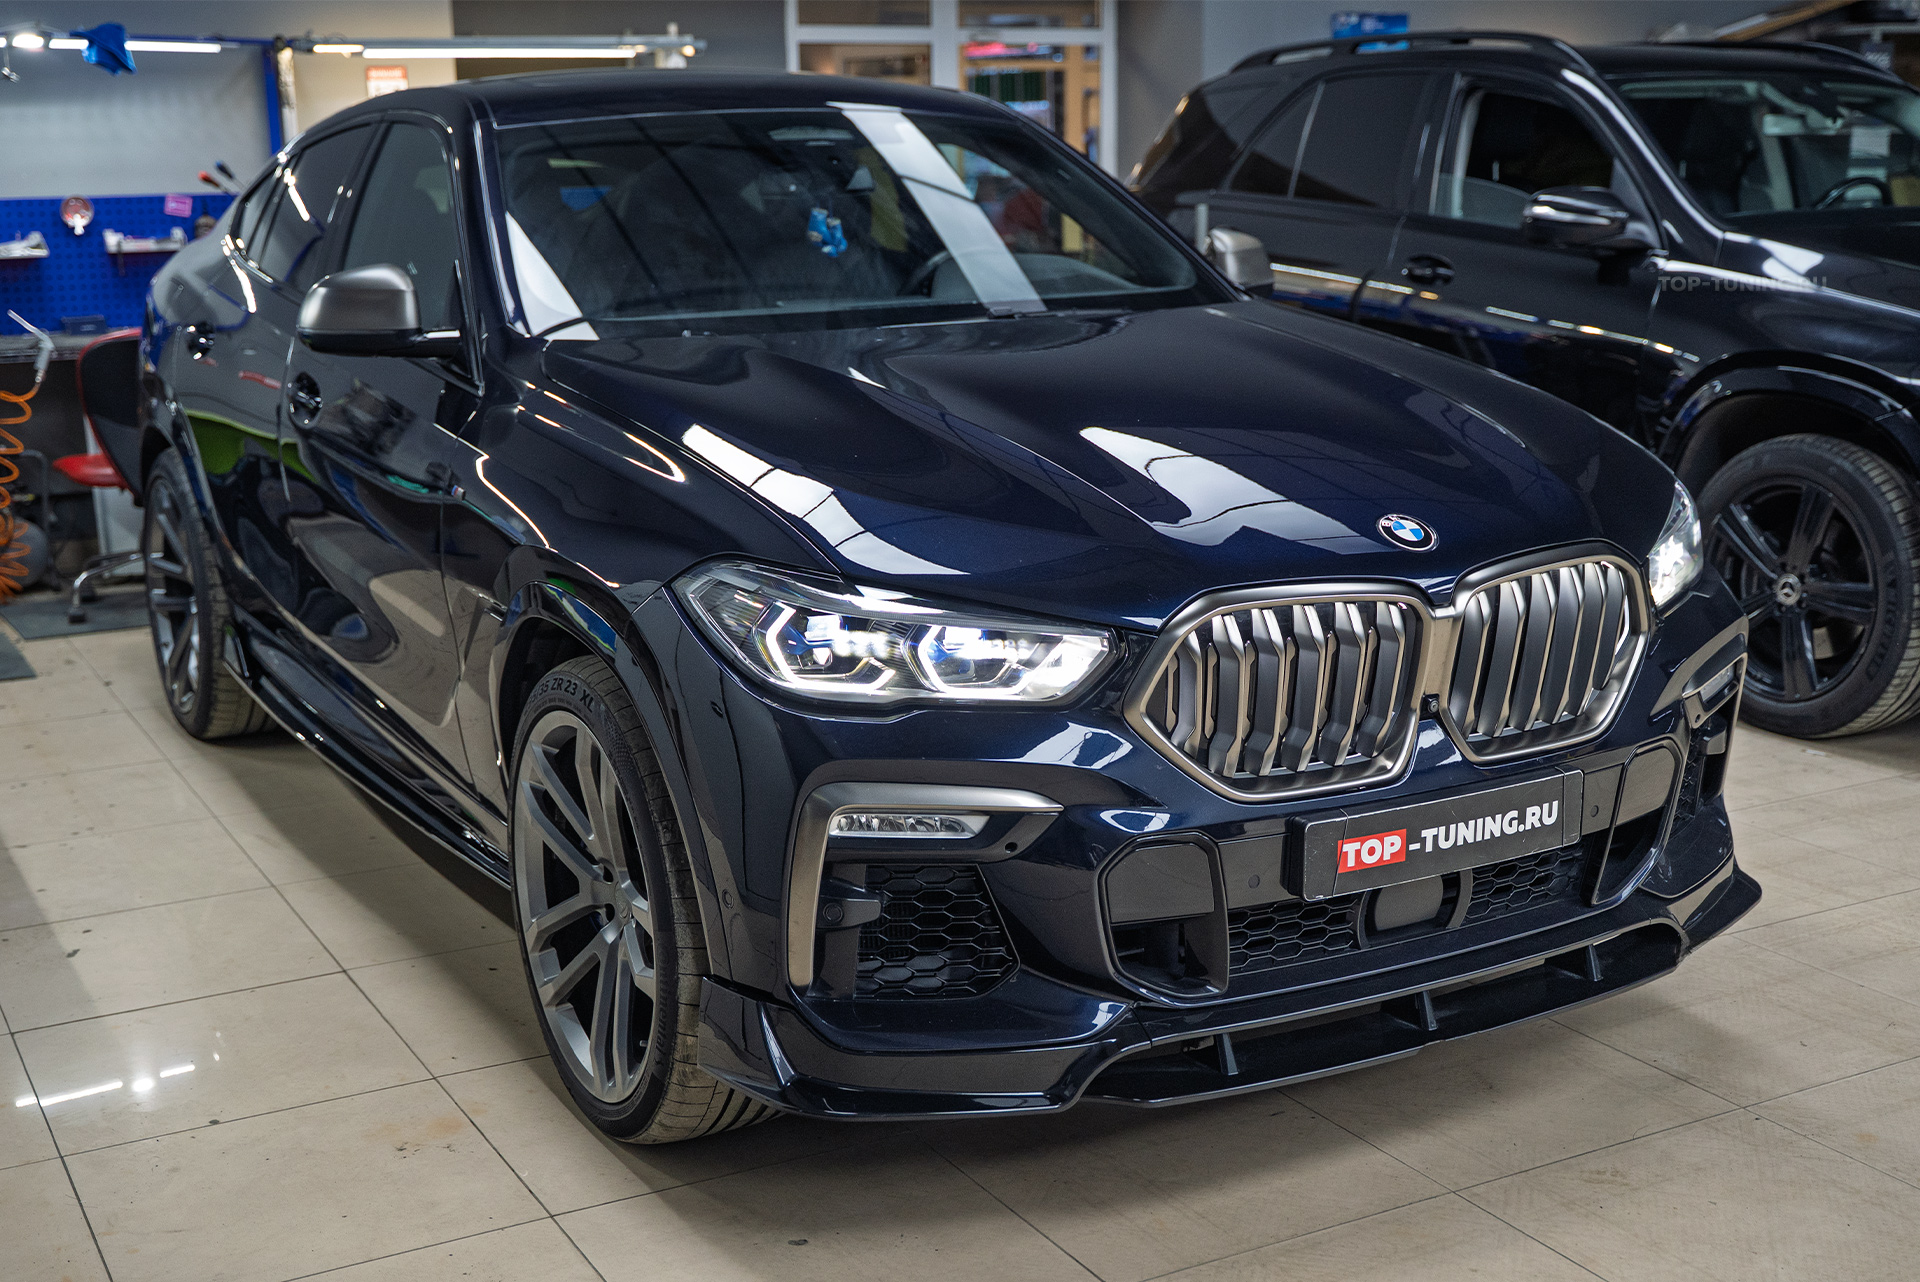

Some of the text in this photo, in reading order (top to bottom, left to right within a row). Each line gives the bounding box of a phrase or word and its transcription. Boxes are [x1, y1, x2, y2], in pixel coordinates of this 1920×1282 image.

[551, 677, 564, 691] ZR
[564, 679, 578, 696] 23
[580, 689, 593, 713] XL
[1341, 834, 1402, 868] TOP
